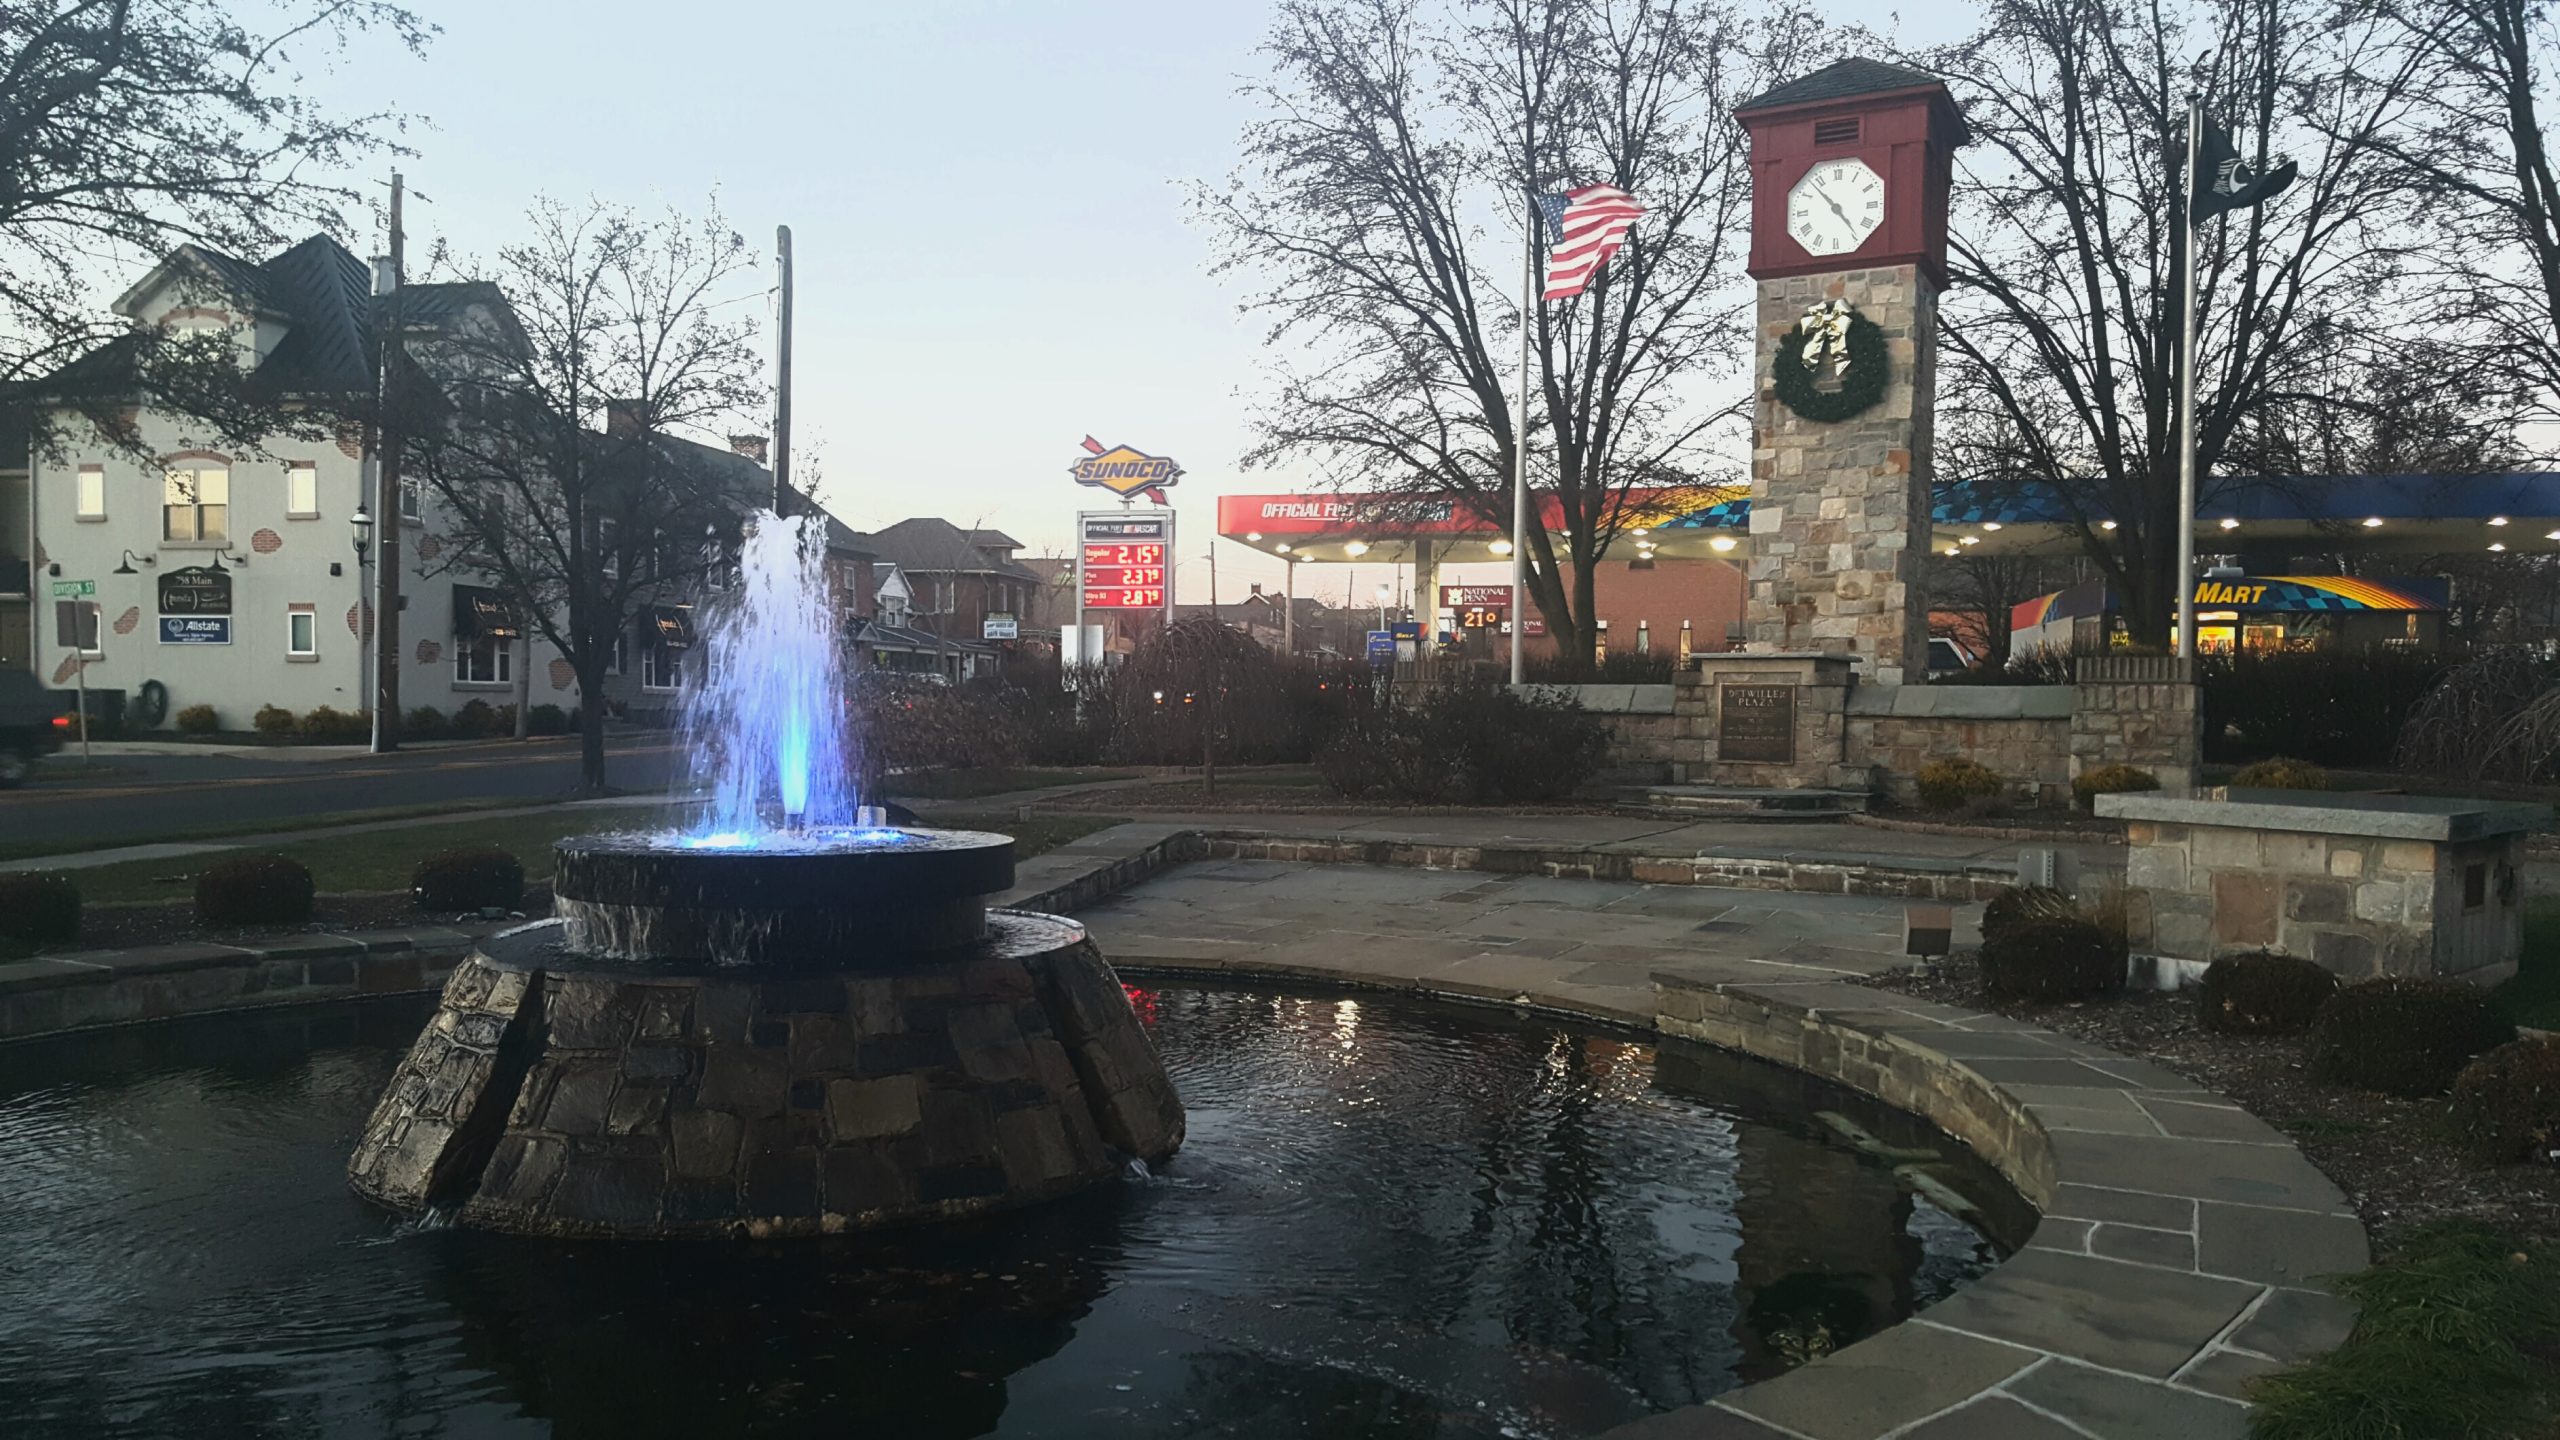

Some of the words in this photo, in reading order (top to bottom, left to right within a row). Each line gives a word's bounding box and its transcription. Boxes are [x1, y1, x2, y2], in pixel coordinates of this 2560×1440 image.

[1079, 461, 1168, 479] SUNOCO
[1262, 503, 1320, 518] OFFICIAL
[191, 576, 212, 585] Main
[1464, 587, 1507, 596] NATIONAL
[2194, 582, 2267, 604] MART
[1464, 594, 1488, 602] PENN
[185, 621, 221, 631] Allstate
[1738, 698, 1775, 706] PLAZA
